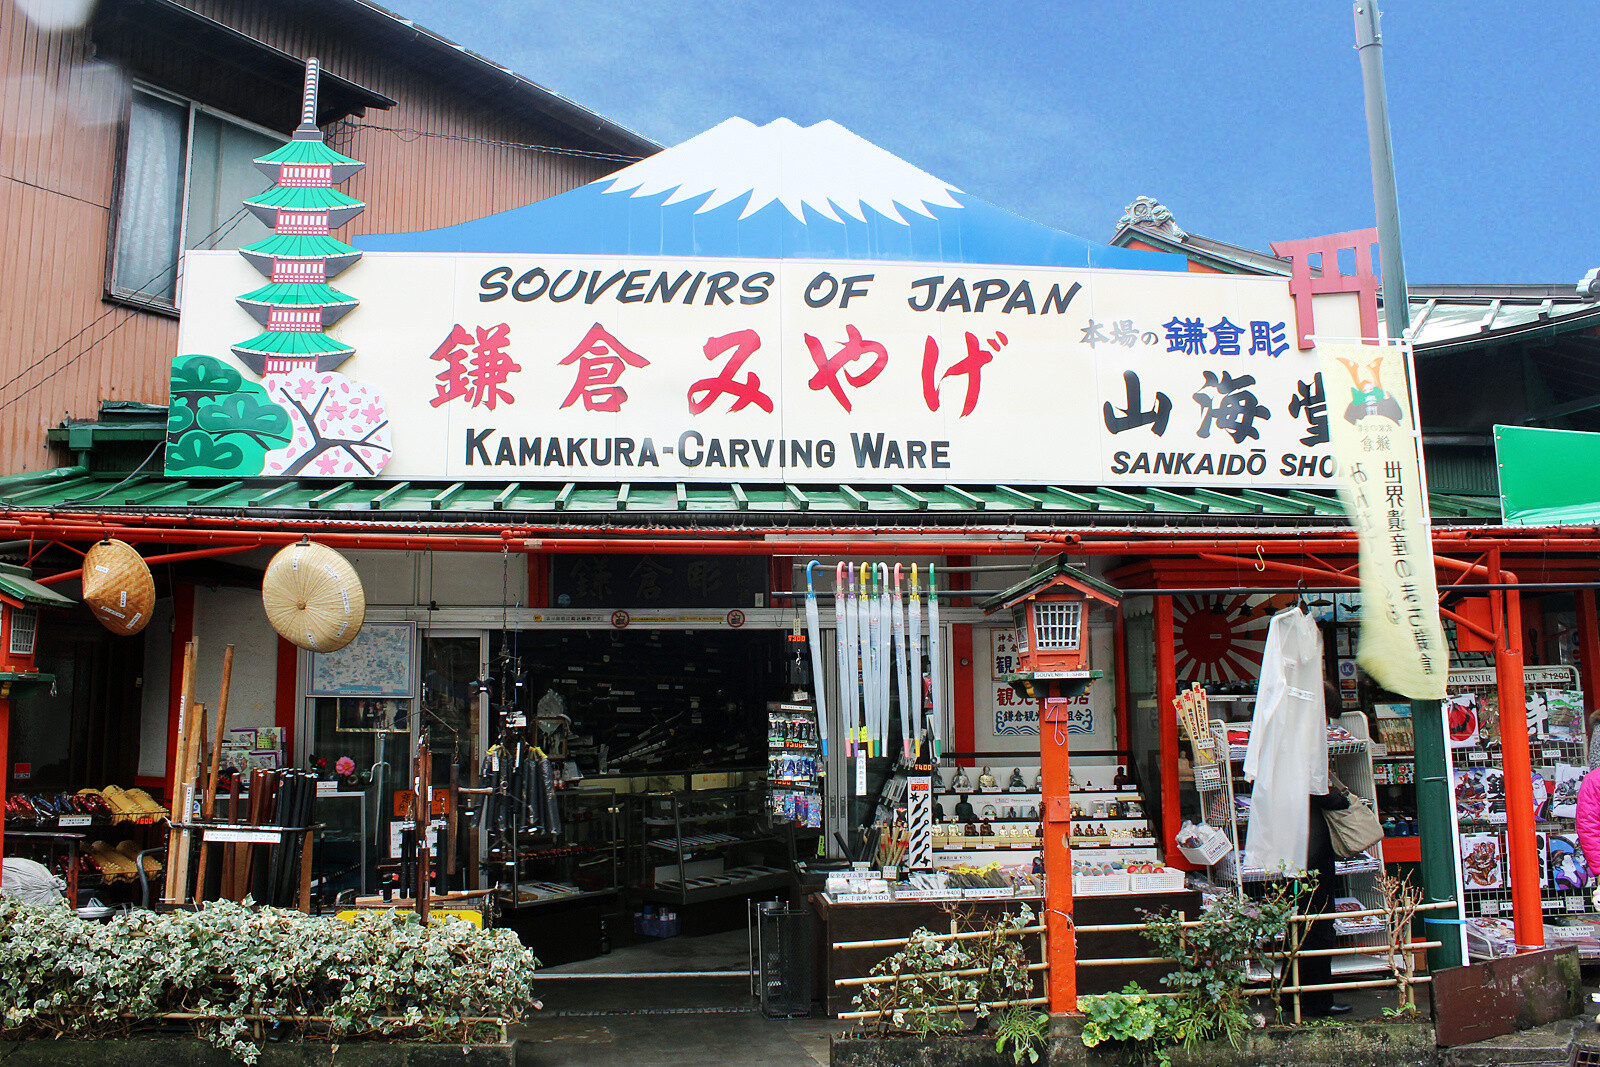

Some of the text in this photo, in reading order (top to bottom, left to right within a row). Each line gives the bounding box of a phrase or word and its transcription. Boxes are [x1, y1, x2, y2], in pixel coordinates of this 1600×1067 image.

[478, 266, 1082, 316] SOUVENIRS OF JAPAN
[1079, 316, 1290, 358] 本場の鎌倉彫
[428, 322, 1009, 420] 鎌倉みやげ
[465, 428, 951, 469] KAMAKURA-CARVING WARE
[1279, 454, 1338, 478] SHO
[1448, 674, 1492, 683] OUVENIR
[1208, 841, 1226, 856] Sample
